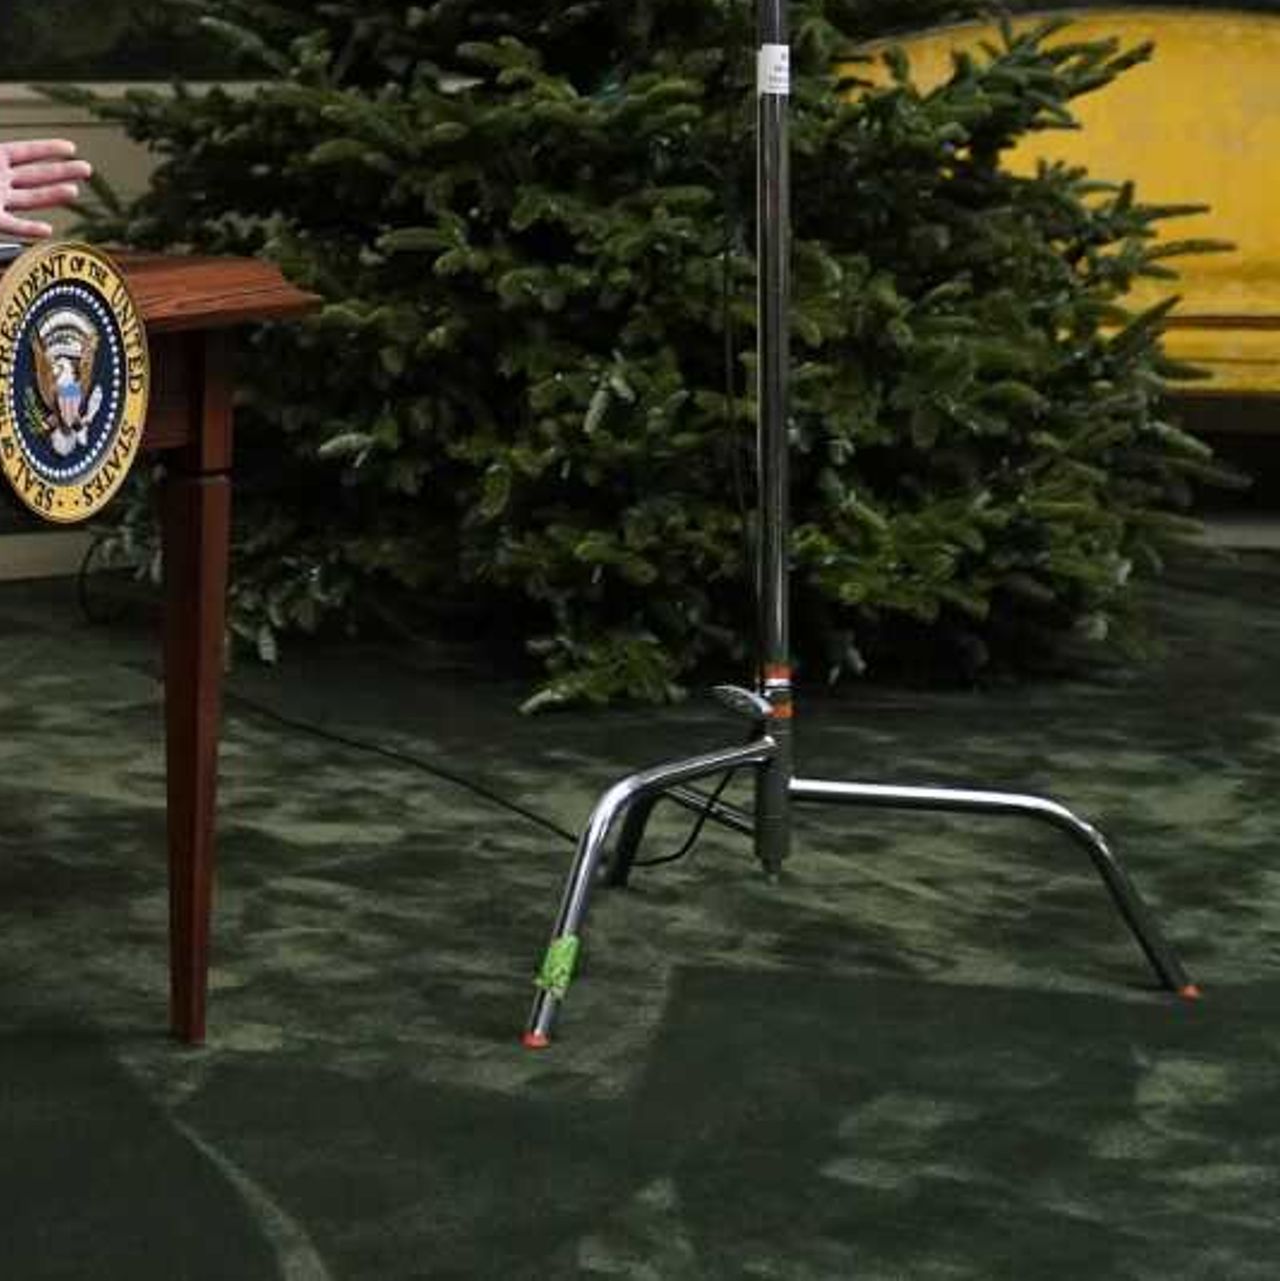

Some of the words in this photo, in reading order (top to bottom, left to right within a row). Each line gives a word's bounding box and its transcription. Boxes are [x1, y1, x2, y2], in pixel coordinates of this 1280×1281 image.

[69, 255, 85, 273] OF
[89, 261, 108, 287] THE
[111, 283, 143, 394] UNITED
[14, 457, 55, 511] SEAL
[82, 419, 137, 507] STATES
